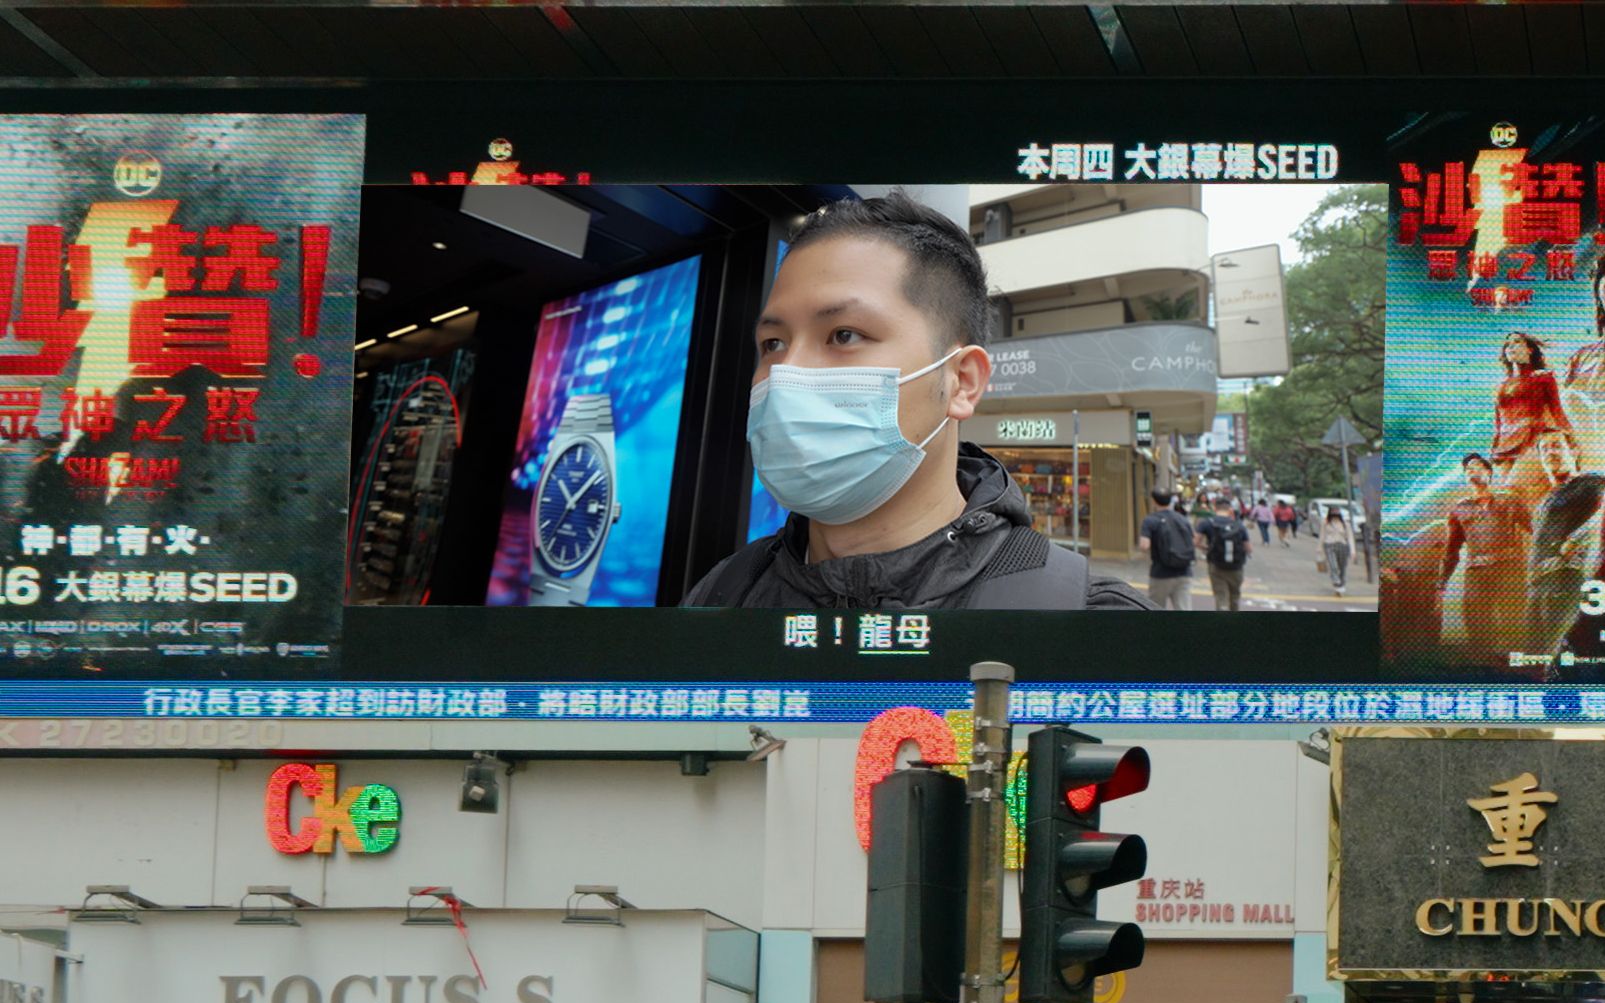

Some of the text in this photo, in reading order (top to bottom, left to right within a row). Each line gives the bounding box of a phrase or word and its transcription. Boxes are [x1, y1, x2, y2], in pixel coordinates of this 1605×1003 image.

[1018, 143, 1338, 181] 本周四 大銀幕爆SEED
[997, 351, 1030, 363] LEASE
[54, 571, 299, 603] 大銀幕爆SEED
[265, 763, 400, 853] Cke
[1136, 903, 1295, 924] SHOPPING MALL
